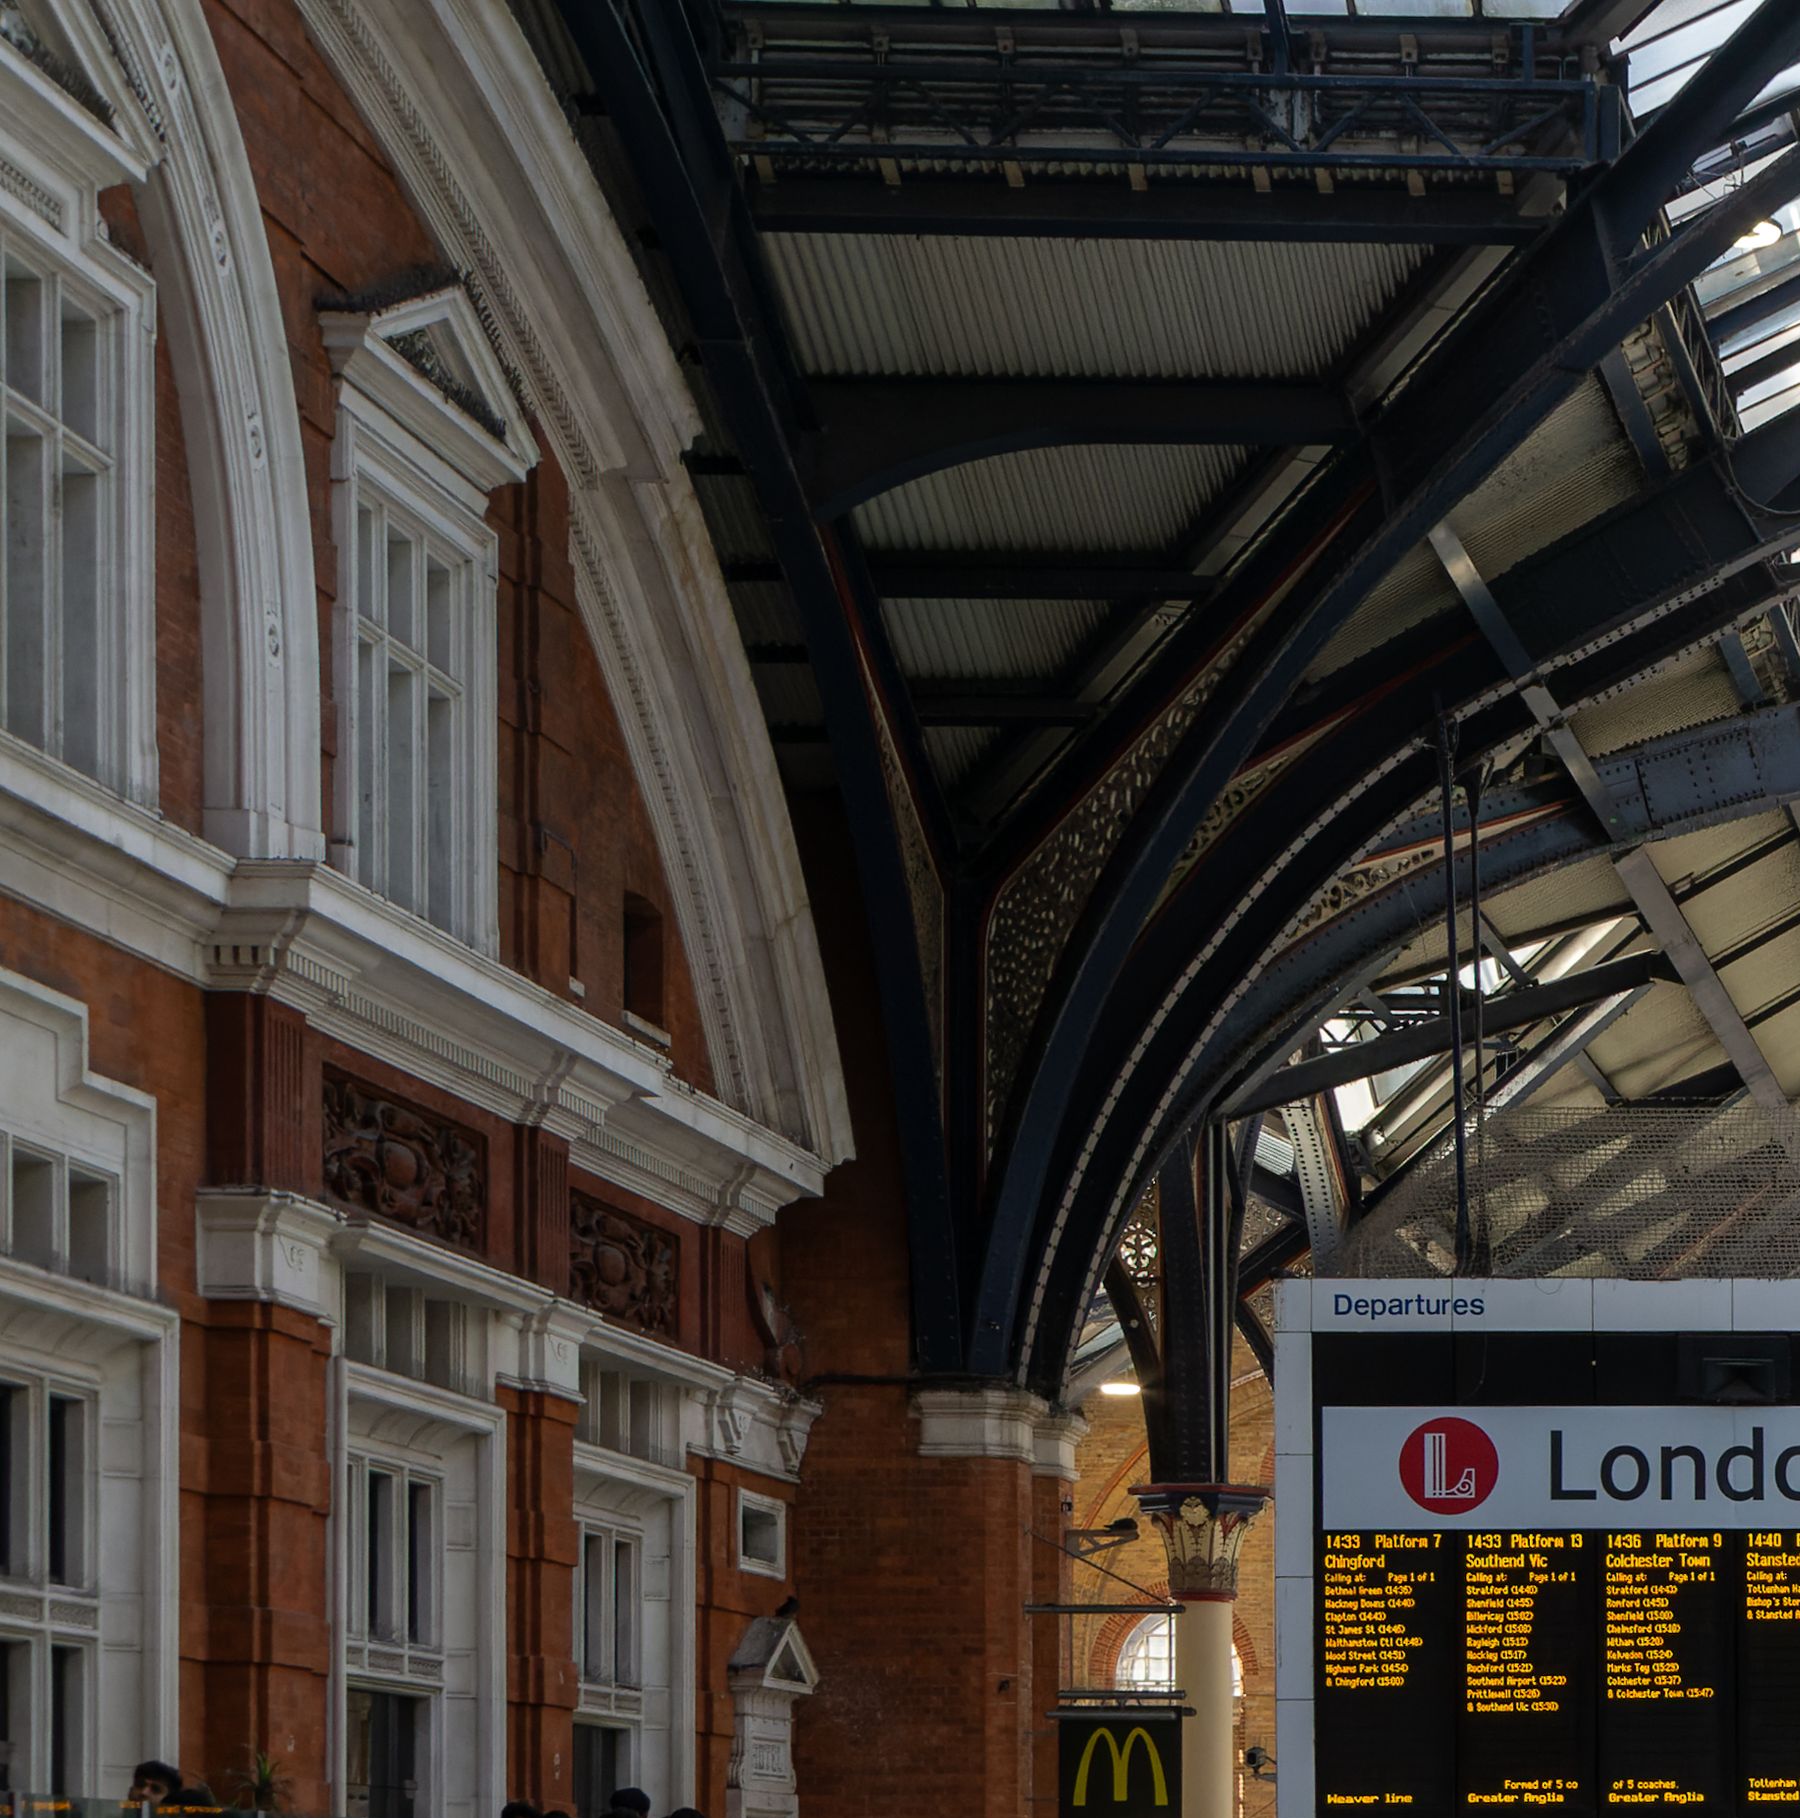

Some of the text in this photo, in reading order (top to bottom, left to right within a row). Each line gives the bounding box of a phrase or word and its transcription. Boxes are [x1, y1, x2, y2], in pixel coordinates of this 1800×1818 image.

[1334, 1292, 1485, 1319] Departures
[1326, 1535, 1441, 1549] 14:33 Platform 7
[1747, 1533, 1782, 1547] 14:40
[1325, 1554, 1385, 1570] Chingford
